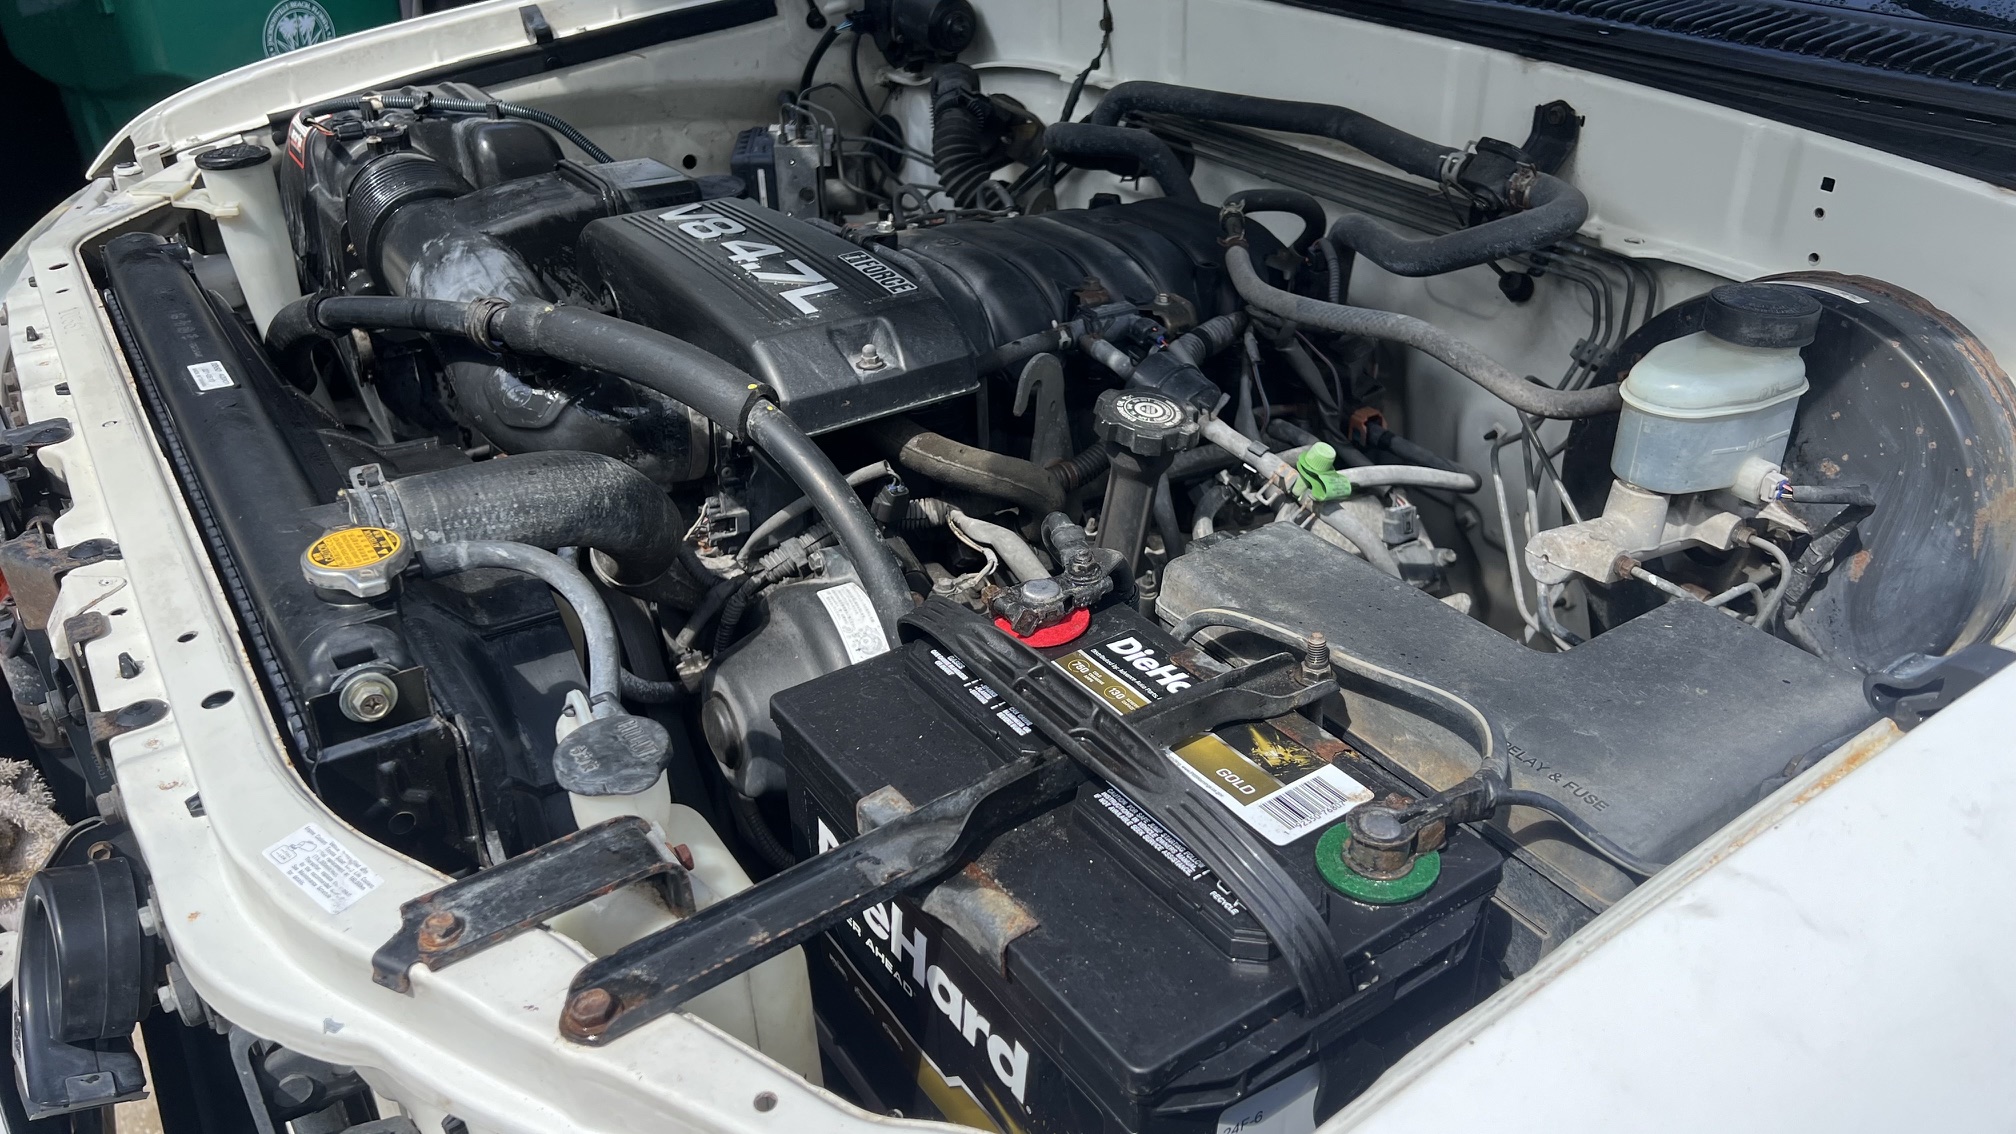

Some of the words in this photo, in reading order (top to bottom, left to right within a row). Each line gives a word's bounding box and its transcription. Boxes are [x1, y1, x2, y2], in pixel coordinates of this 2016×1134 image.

[311, 5, 330, 31] FLORIDA
[658, 203, 746, 240] V8
[721, 240, 839, 316] 4.7L
[1072, 661, 1089, 674] 750
[1108, 687, 1125, 700] 130
[1216, 768, 1256, 795] GOLD
[1548, 773, 1562, 783] &
[1563, 781, 1610, 811] FUSE
[1127, 805, 1138, 813] FOR
[1137, 813, 1151, 823] SAFE
[1184, 850, 1205, 868] FOLLOW
[1209, 890, 1239, 916] RECYCLE
[865, 938, 913, 997] AHEAD
